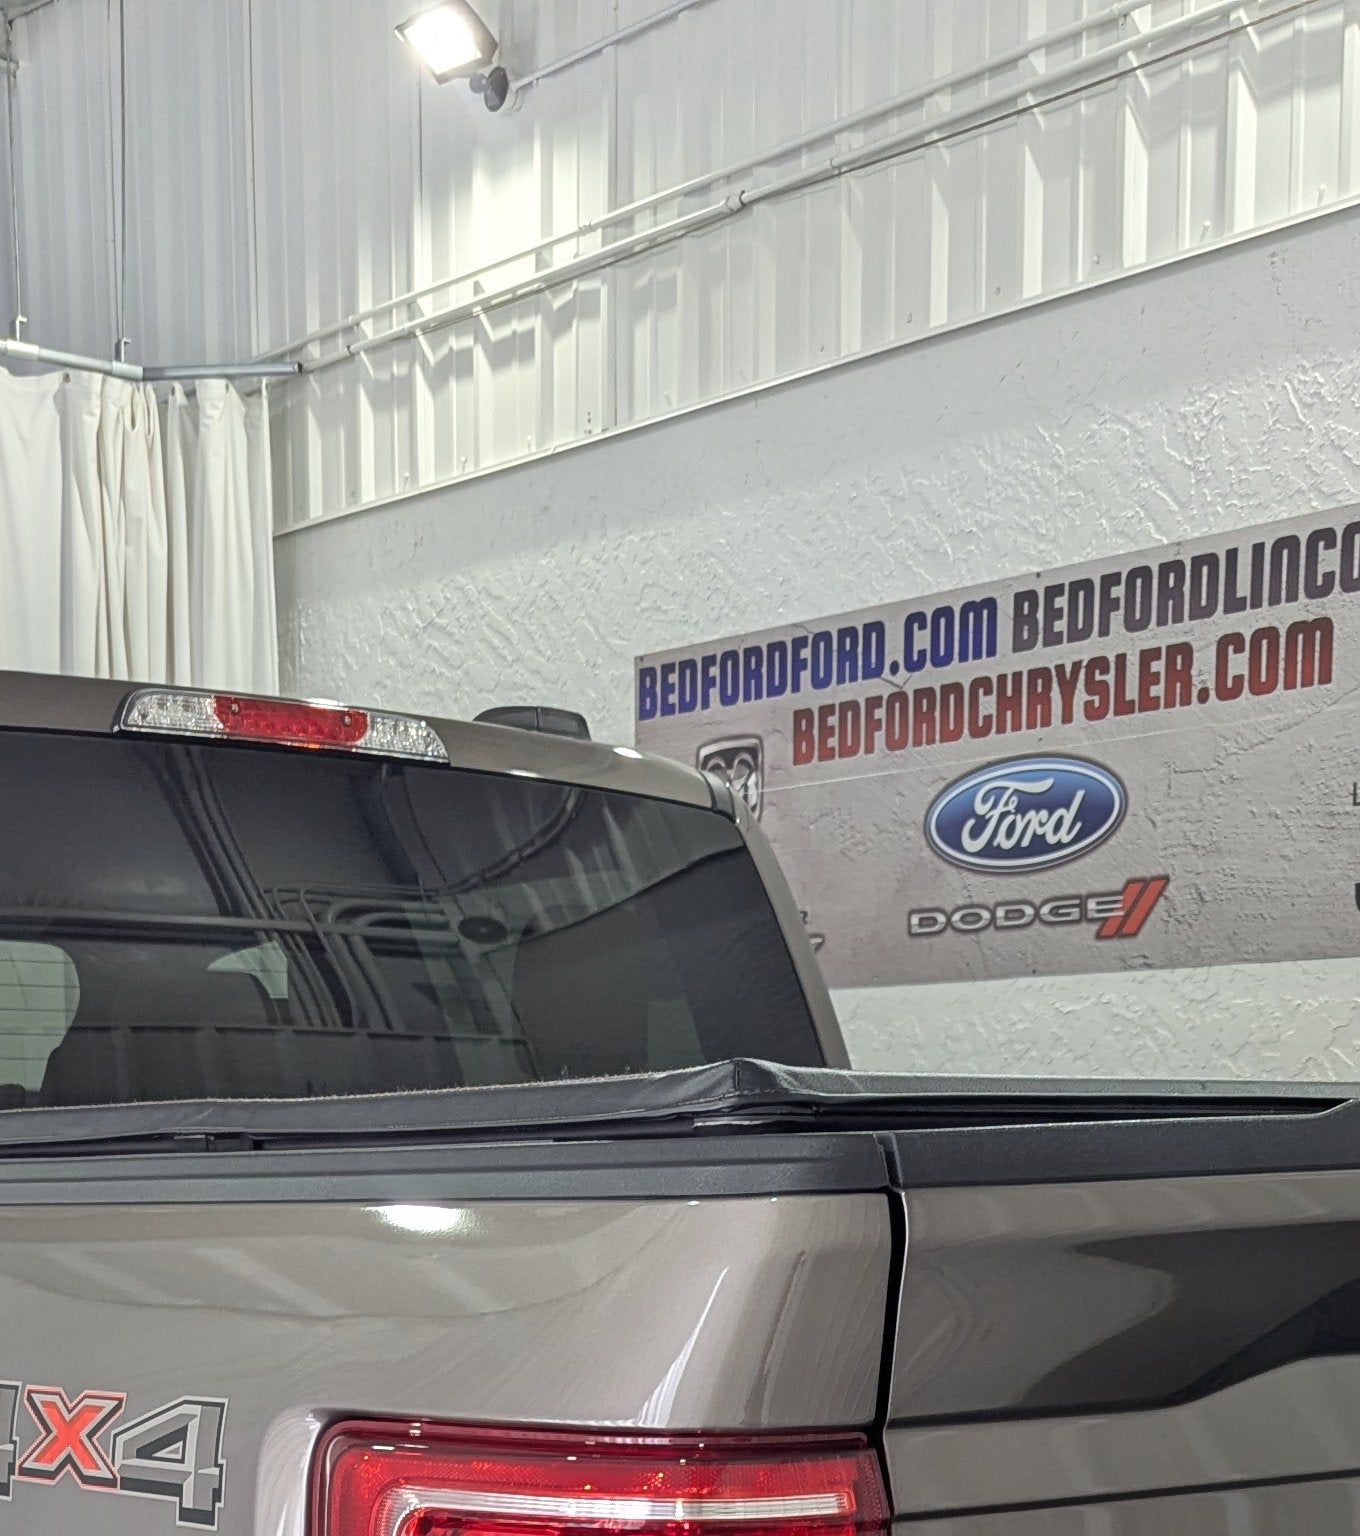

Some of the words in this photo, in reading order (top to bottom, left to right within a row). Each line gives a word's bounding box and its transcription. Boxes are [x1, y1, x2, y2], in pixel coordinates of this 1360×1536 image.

[639, 597, 997, 721] BEDFORDFORD.COM
[792, 616, 1334, 766] BEDFORDCHRYSLER.COM
[961, 777, 1086, 853] Ford
[909, 893, 1126, 936] DODGE
